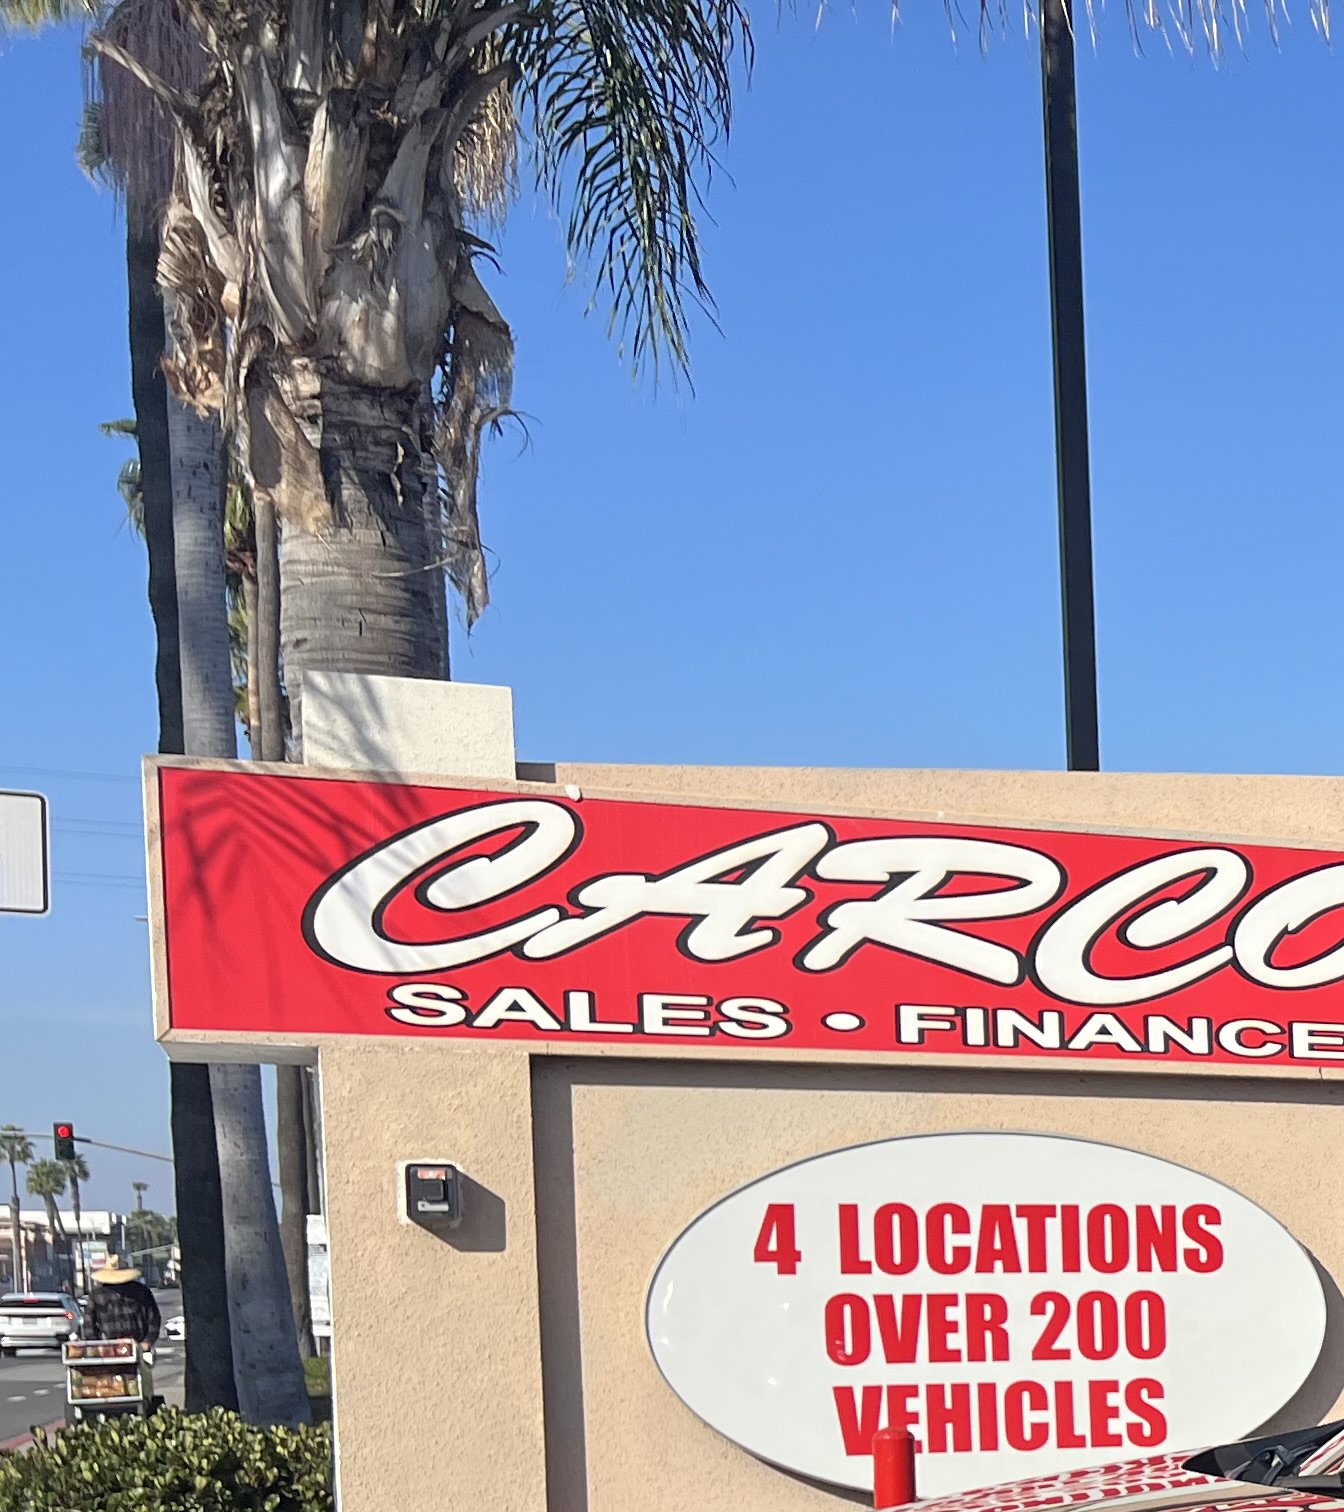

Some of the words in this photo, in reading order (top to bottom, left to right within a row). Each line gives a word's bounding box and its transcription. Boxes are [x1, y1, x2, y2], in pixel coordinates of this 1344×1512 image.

[385, 983, 792, 1040] SALES
[753, 1203, 801, 1275] 4
[838, 1202, 1224, 1275] LOCATIONS
[825, 1292, 1010, 1366] OVER
[1029, 1290, 1167, 1361] 200
[832, 1377, 1168, 1456] VEHICLES
